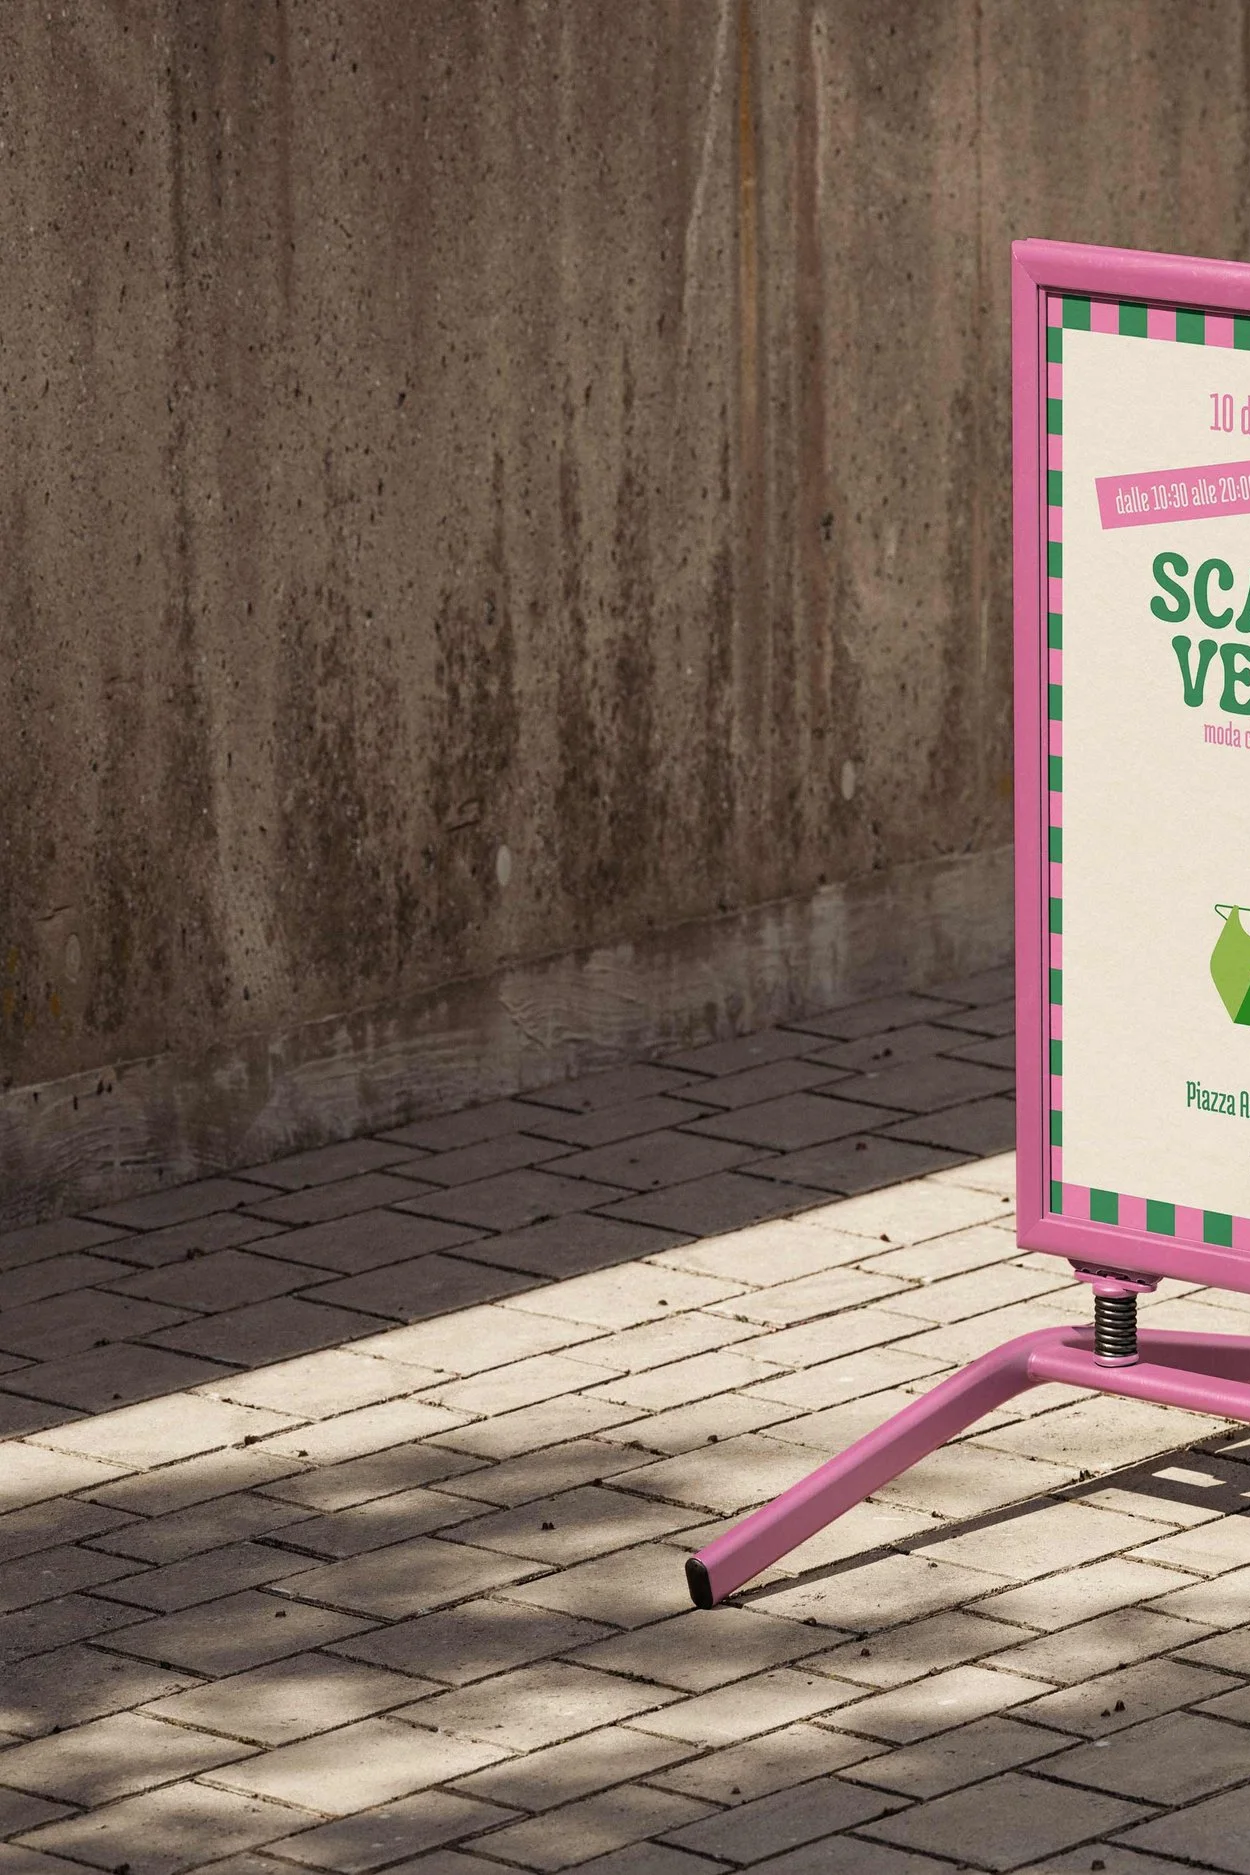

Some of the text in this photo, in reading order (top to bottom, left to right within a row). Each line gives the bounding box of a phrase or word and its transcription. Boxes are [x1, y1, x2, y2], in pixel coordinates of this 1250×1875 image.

[1209, 393, 1234, 432] 10
[1115, 487, 1150, 514] dalle
[1150, 482, 1189, 511] 10:30
[1191, 479, 1218, 506] alle
[1204, 721, 1241, 748] moda
[1186, 1081, 1236, 1116] Piazza
